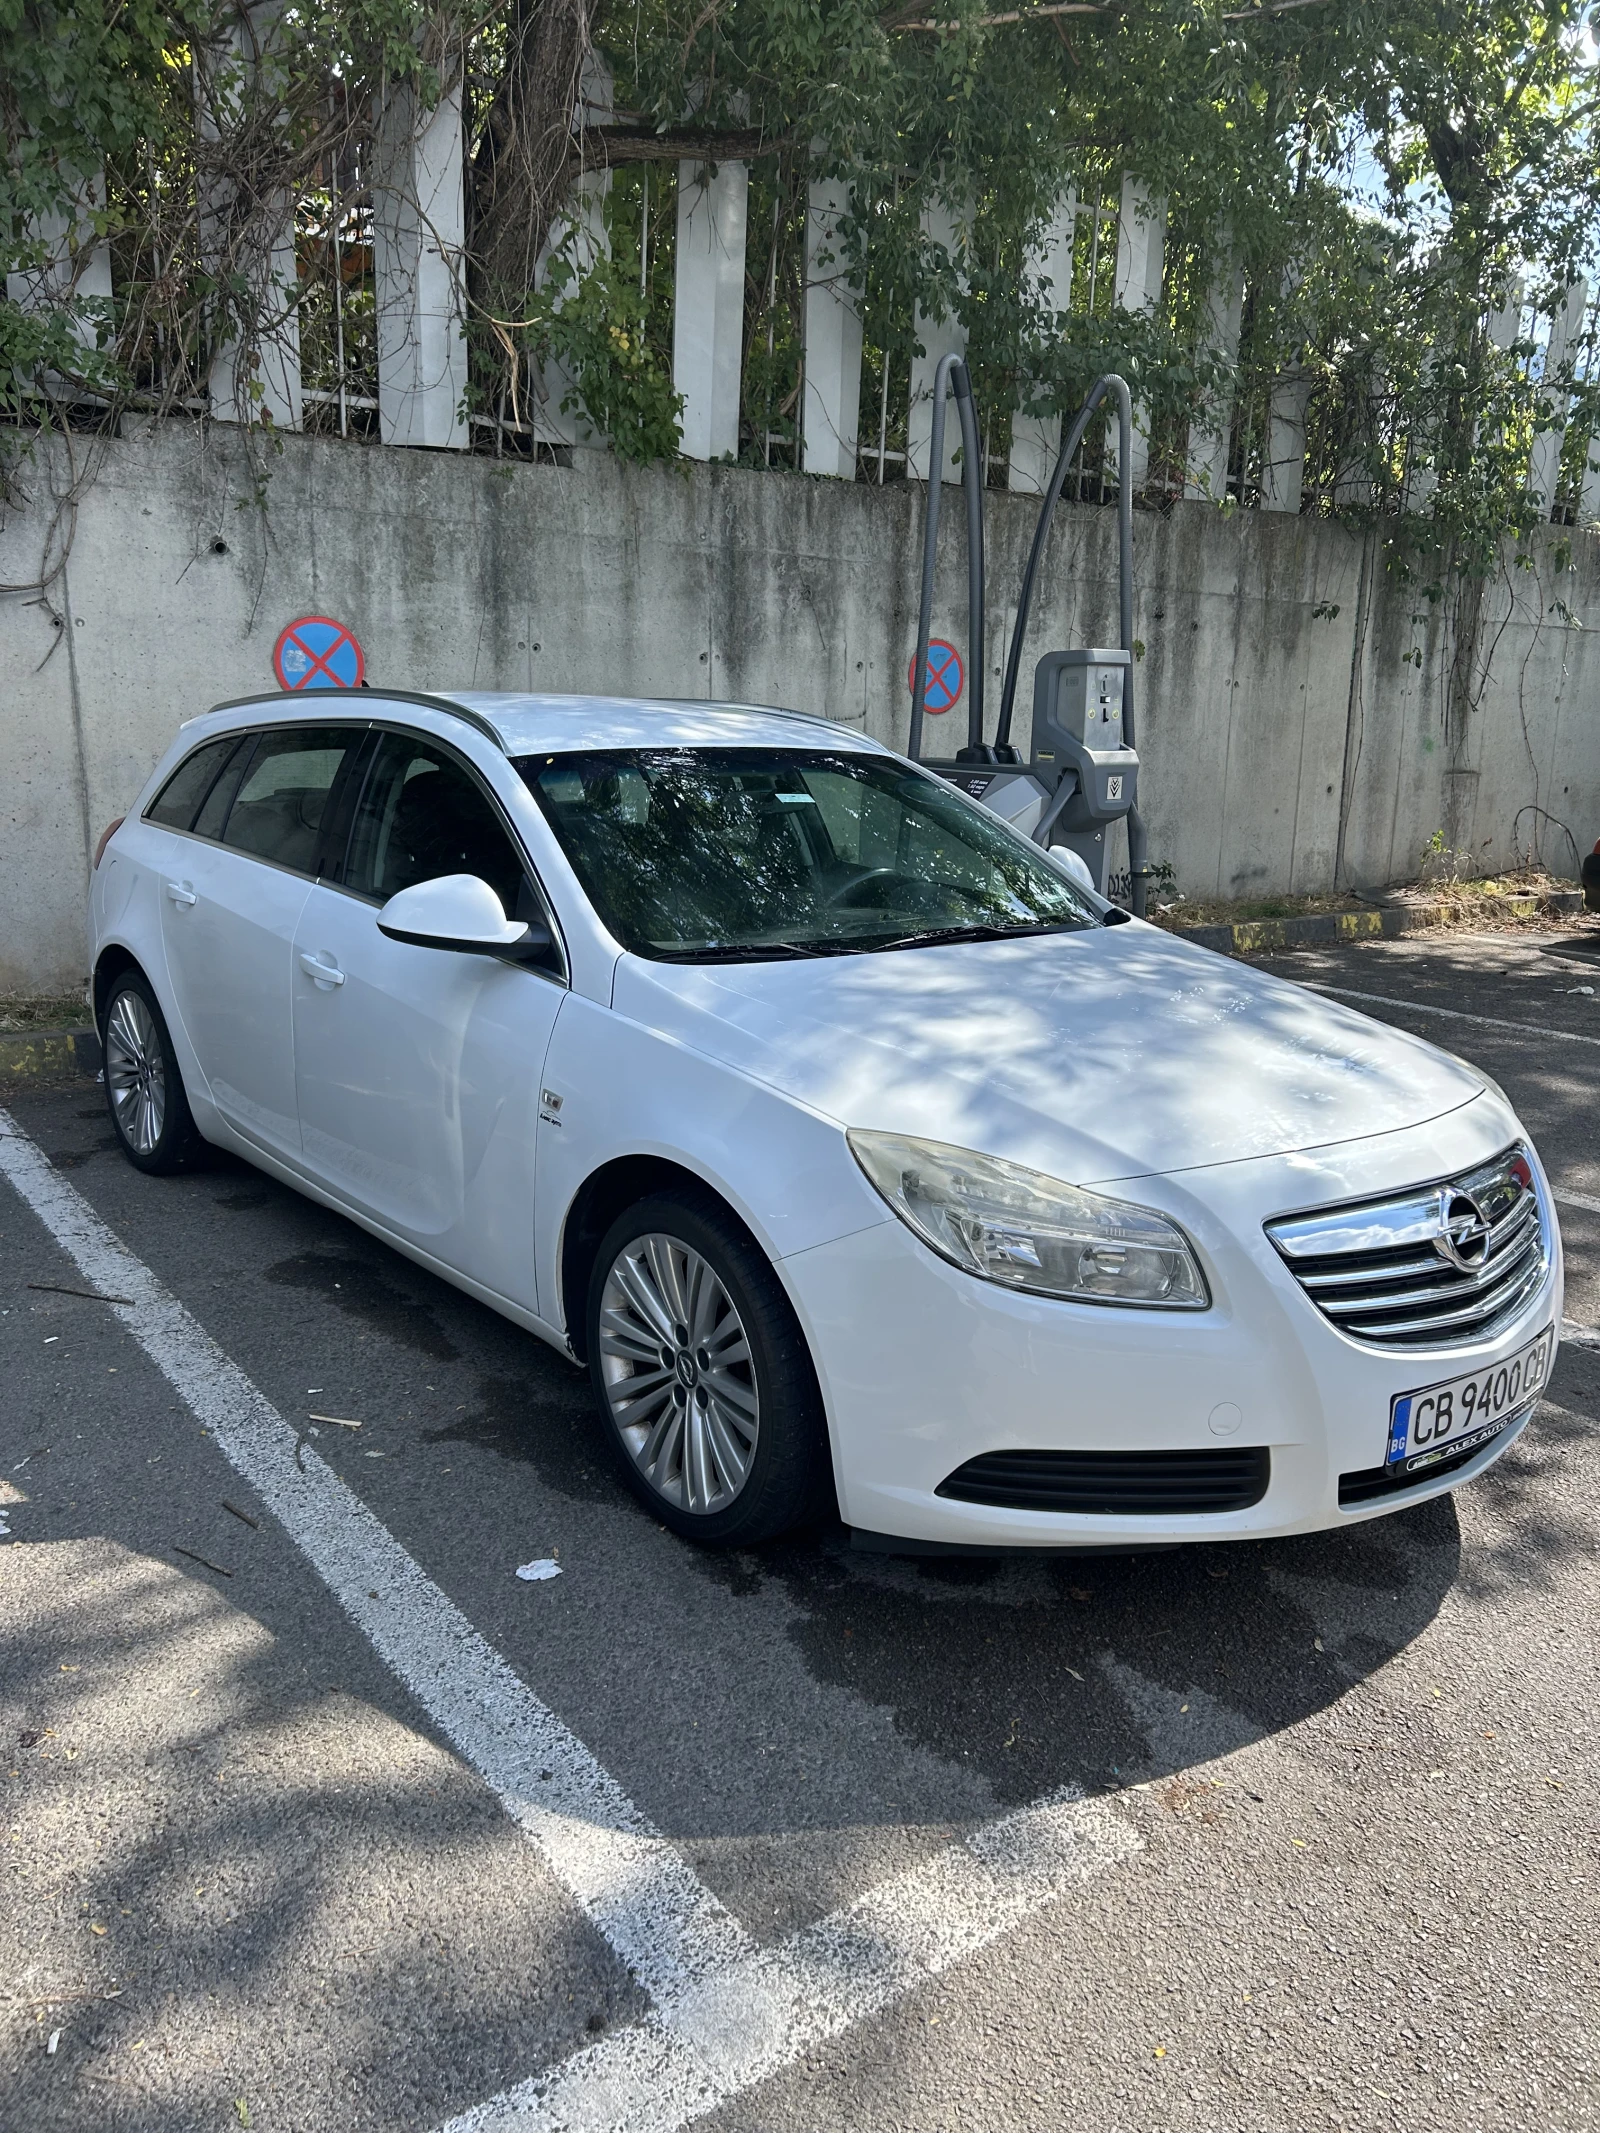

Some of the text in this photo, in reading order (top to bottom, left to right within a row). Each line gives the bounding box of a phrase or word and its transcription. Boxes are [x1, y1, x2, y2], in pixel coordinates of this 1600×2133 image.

[1414, 1391, 1454, 1445] CB
[1461, 1359, 1521, 1428] 9400
[1523, 1341, 1547, 1392] CB
[1391, 1437, 1406, 1453] BG
[1446, 1420, 1508, 1454] ALEX AUTO
